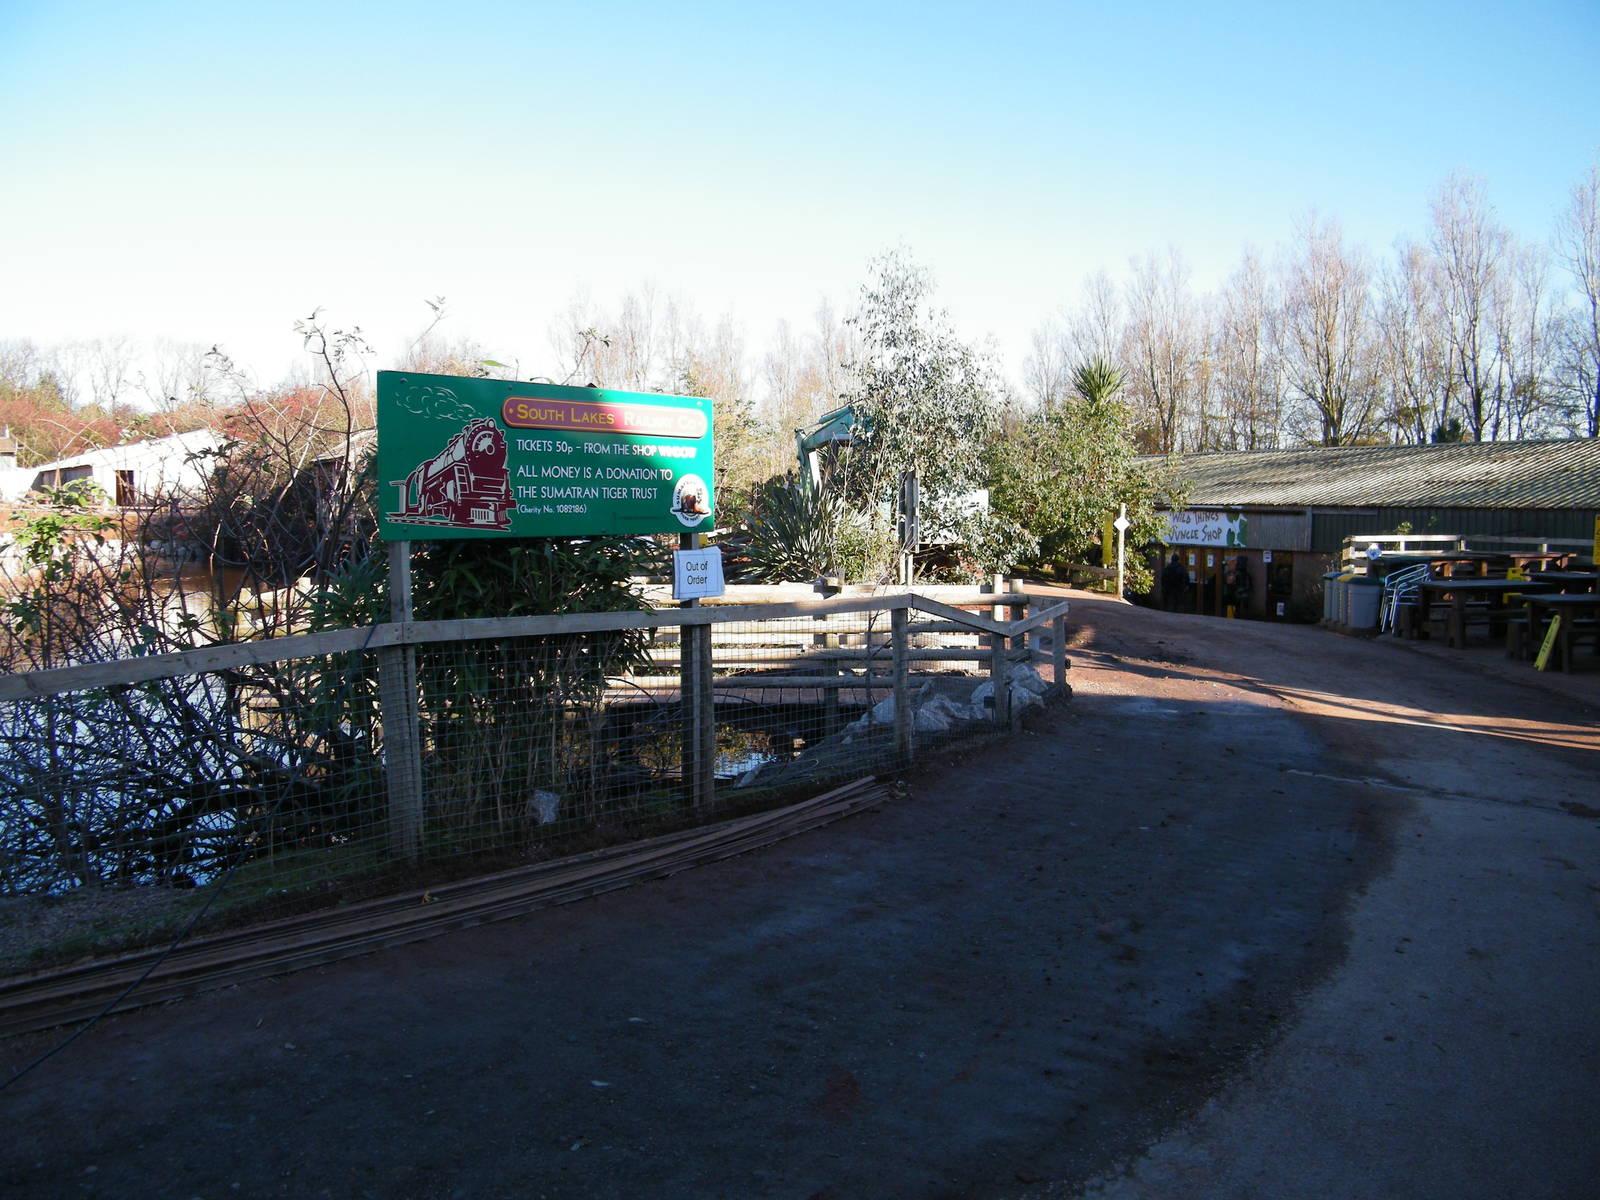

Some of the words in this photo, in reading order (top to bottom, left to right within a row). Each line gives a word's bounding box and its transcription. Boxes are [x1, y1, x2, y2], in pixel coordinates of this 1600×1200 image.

[516, 403, 565, 422] SOUTH
[570, 407, 616, 425] LAKES
[516, 439, 553, 453] TICKETS
[556, 440, 574, 455] 50p
[583, 442, 611, 455] FROM
[612, 443, 630, 455] THE
[632, 444, 657, 457] SHOP
[516, 465, 539, 478] ALL
[541, 465, 581, 479] MONEY
[583, 466, 592, 479] IS
[594, 468, 604, 479] A
[606, 467, 658, 480] DONATION
[659, 468, 673, 481] TO
[516, 485, 538, 498] THE
[540, 486, 599, 499] SUMATRAN
[601, 487, 628, 499] TIGER
[630, 487, 658, 499] TRUST
[1168, 526, 1199, 541] JUNGLE
[1201, 524, 1223, 542] SHOP
[685, 561, 699, 571] Out
[700, 560, 709, 571] of
[687, 574, 708, 585] Order
